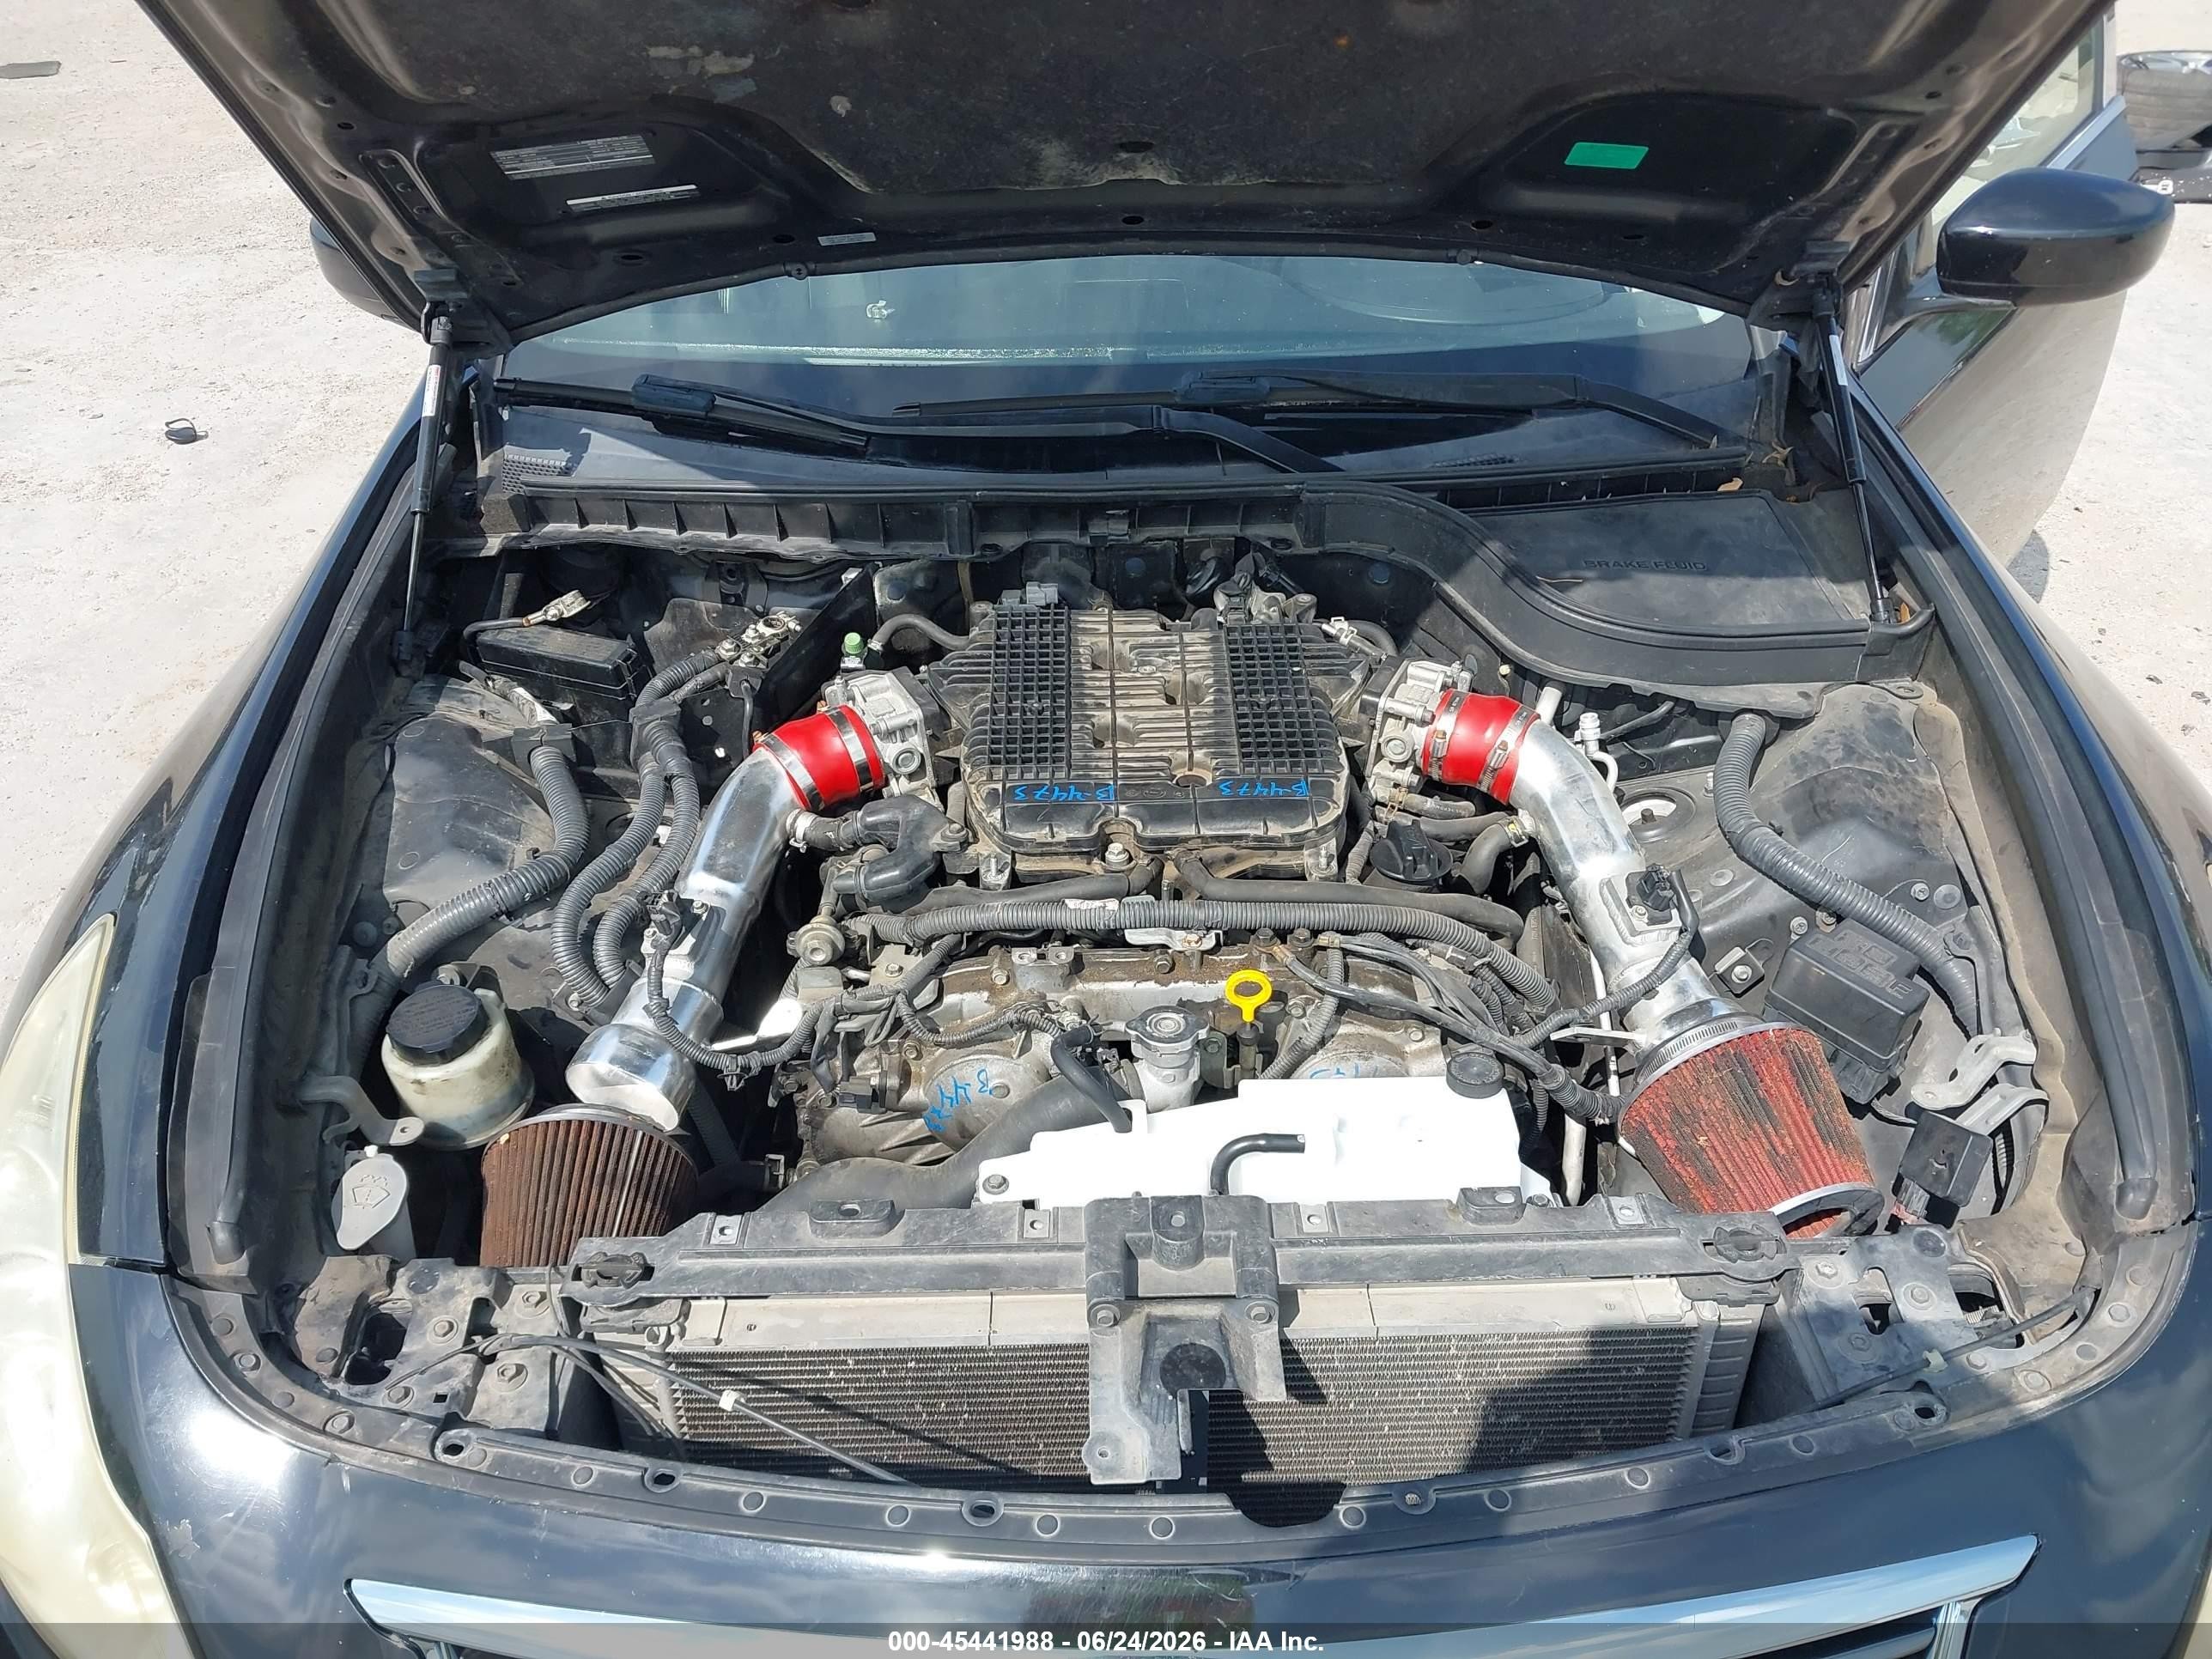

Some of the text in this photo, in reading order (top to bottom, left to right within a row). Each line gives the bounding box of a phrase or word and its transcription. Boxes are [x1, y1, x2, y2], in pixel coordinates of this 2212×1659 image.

[1583, 559, 1707, 571] BRAKE FLUID
[1012, 782, 1116, 803] B-4473
[1217, 778, 1310, 798] B-4473
